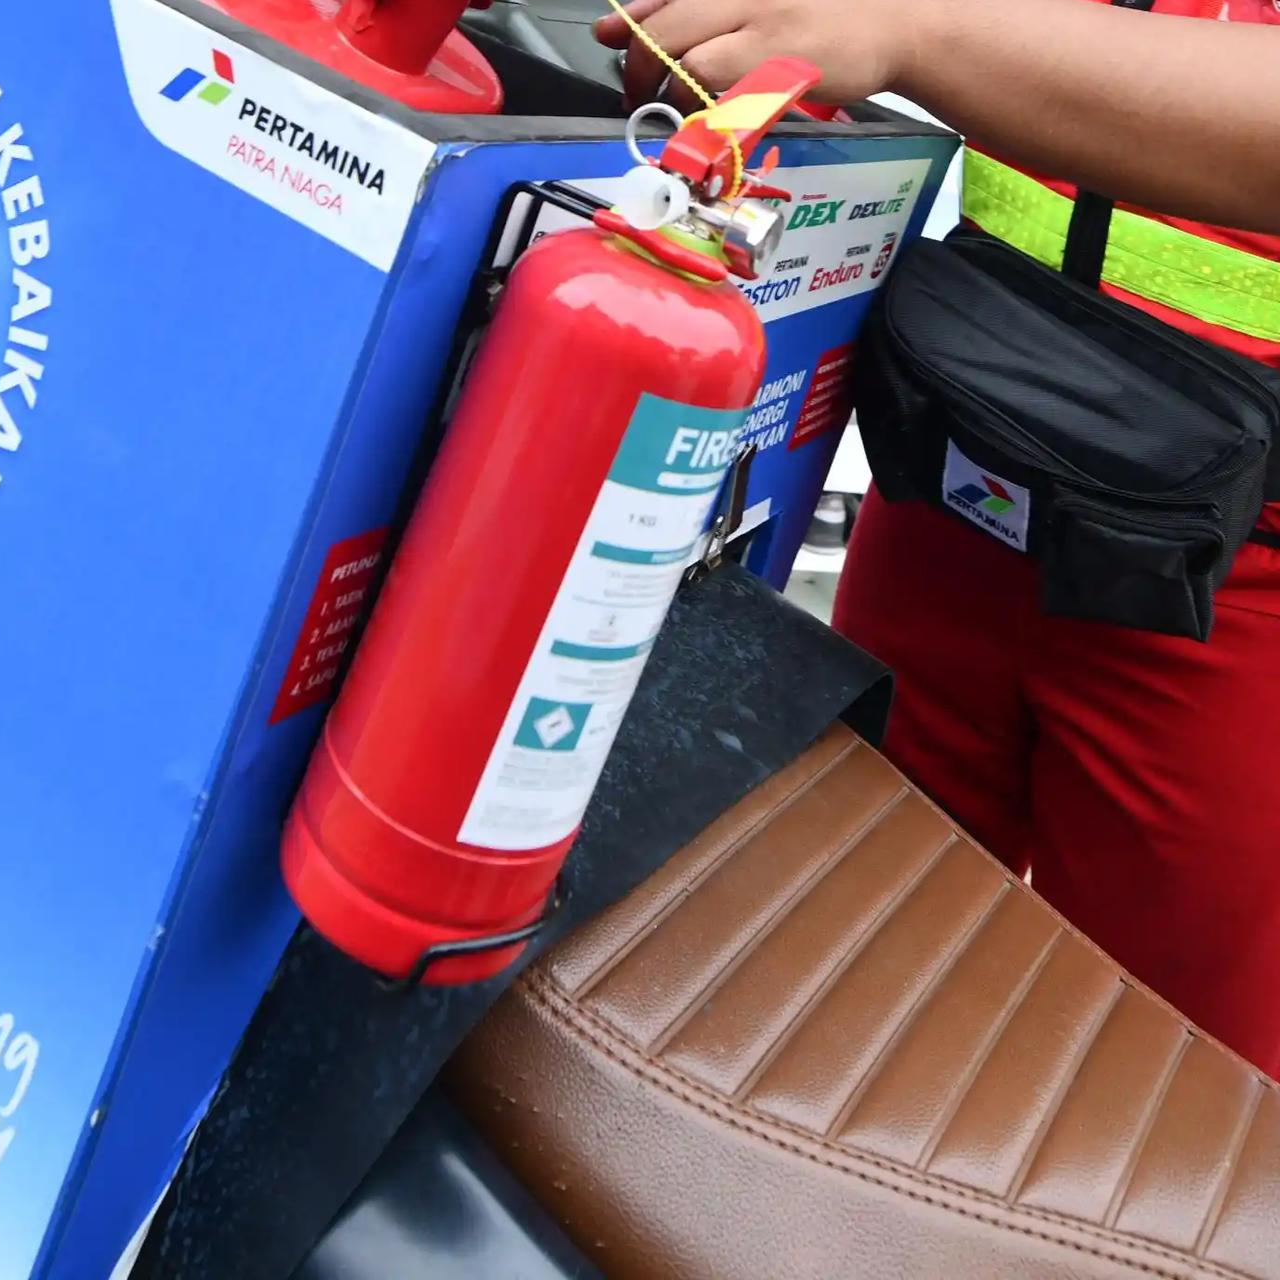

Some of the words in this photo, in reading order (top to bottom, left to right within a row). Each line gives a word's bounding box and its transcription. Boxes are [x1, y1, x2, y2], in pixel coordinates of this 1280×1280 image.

[238, 97, 385, 196] PERTAMINA
[226, 135, 276, 178] PATRA
[280, 164, 343, 216] NIAGA
[785, 199, 846, 231] DEX
[848, 197, 906, 221] DEXLITE
[808, 261, 863, 292] Enduro
[946, 490, 1021, 544] PERTAMINA
